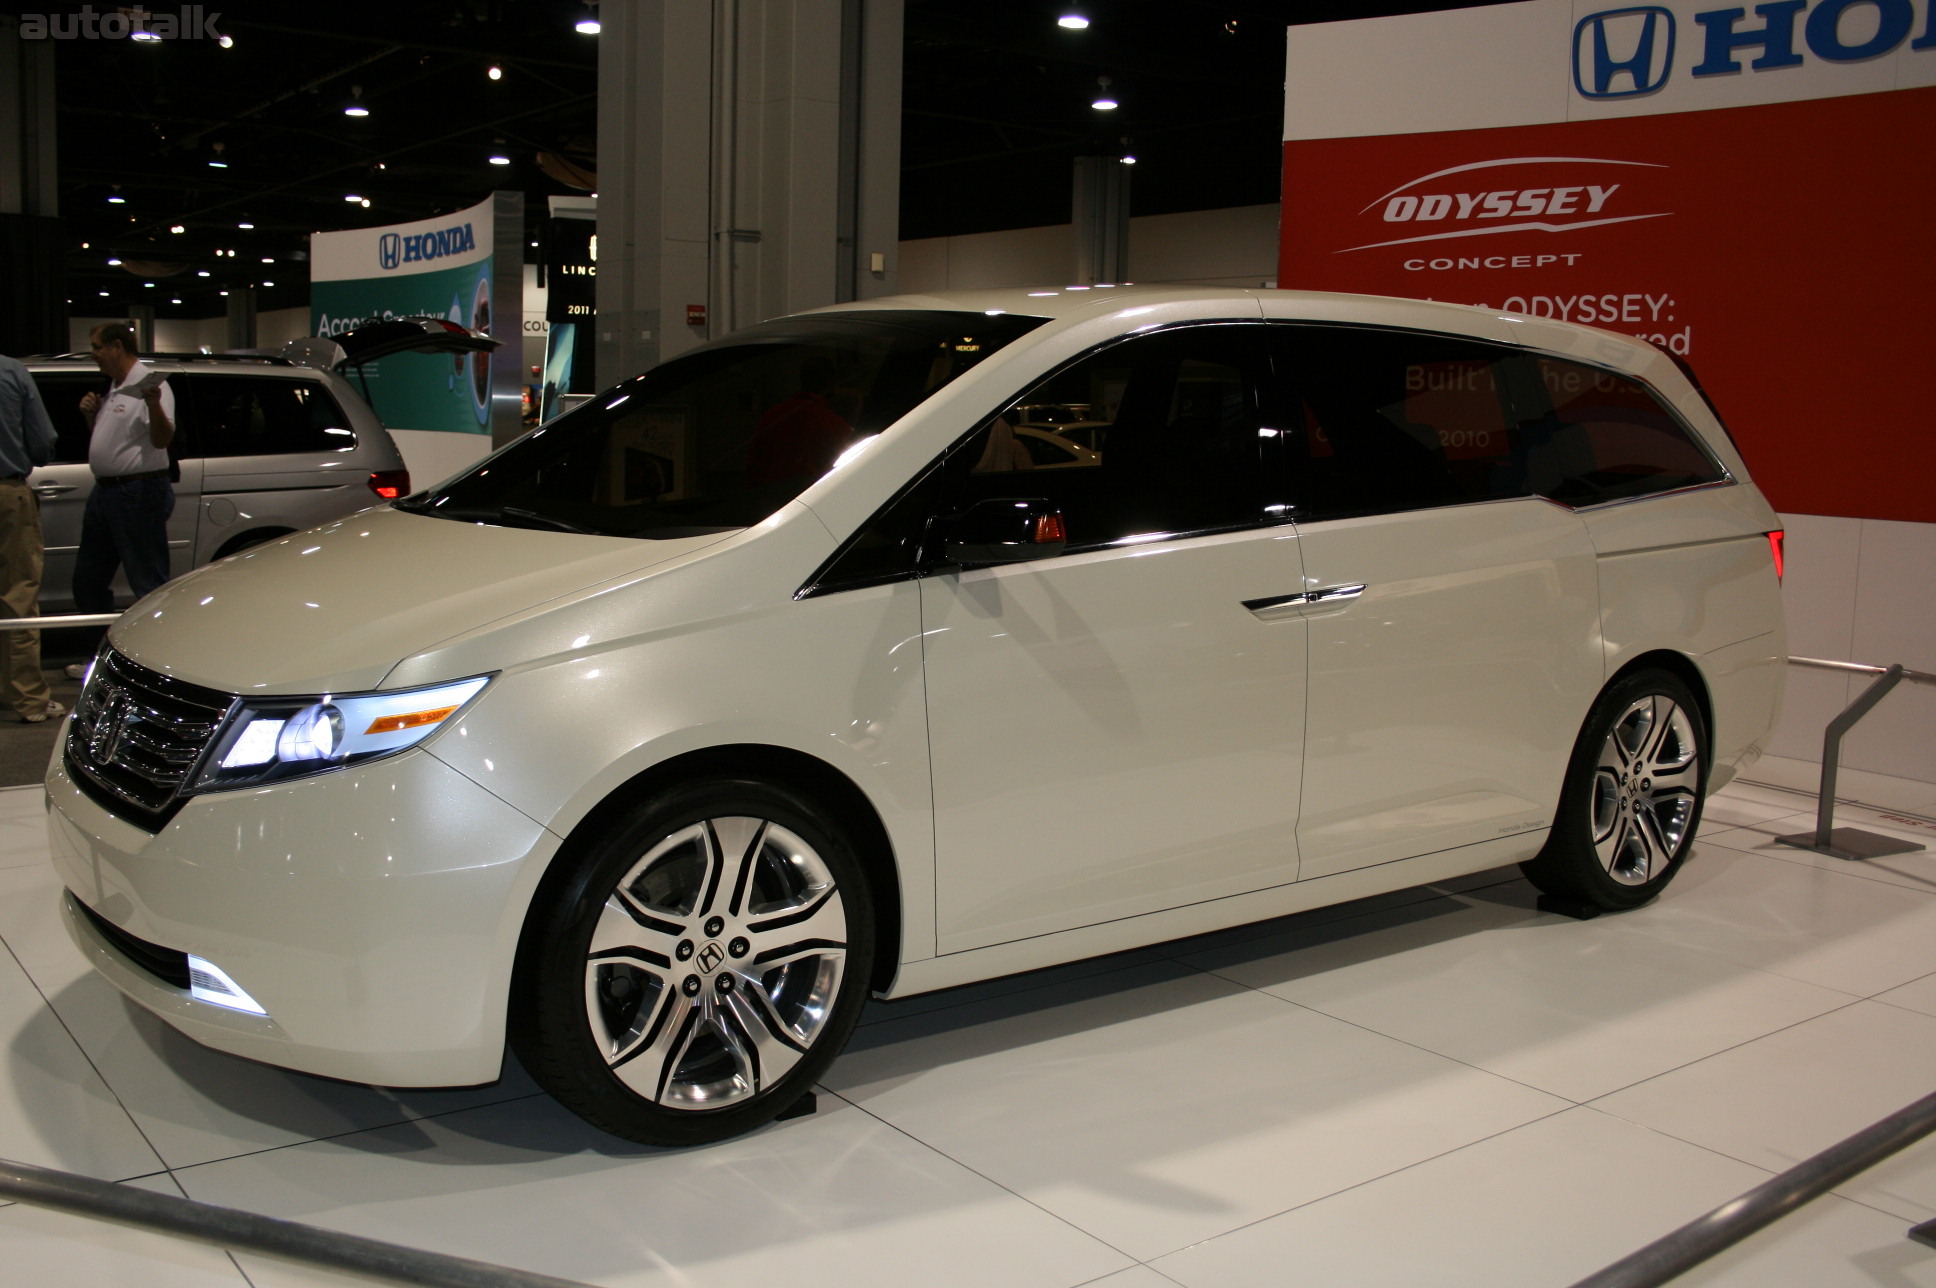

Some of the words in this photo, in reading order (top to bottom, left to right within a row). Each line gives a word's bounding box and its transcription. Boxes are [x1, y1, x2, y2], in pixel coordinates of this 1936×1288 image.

[1383, 184, 1621, 222] ODYSSEY
[403, 223, 475, 262] HONDA
[1403, 254, 1582, 271] CONCEPT
[568, 305, 590, 315] 2011
[1502, 293, 1676, 323] ODYSSEY:
[1406, 364, 1476, 391] Built
[1542, 366, 1581, 392] he
[1438, 430, 1490, 447] 2010
